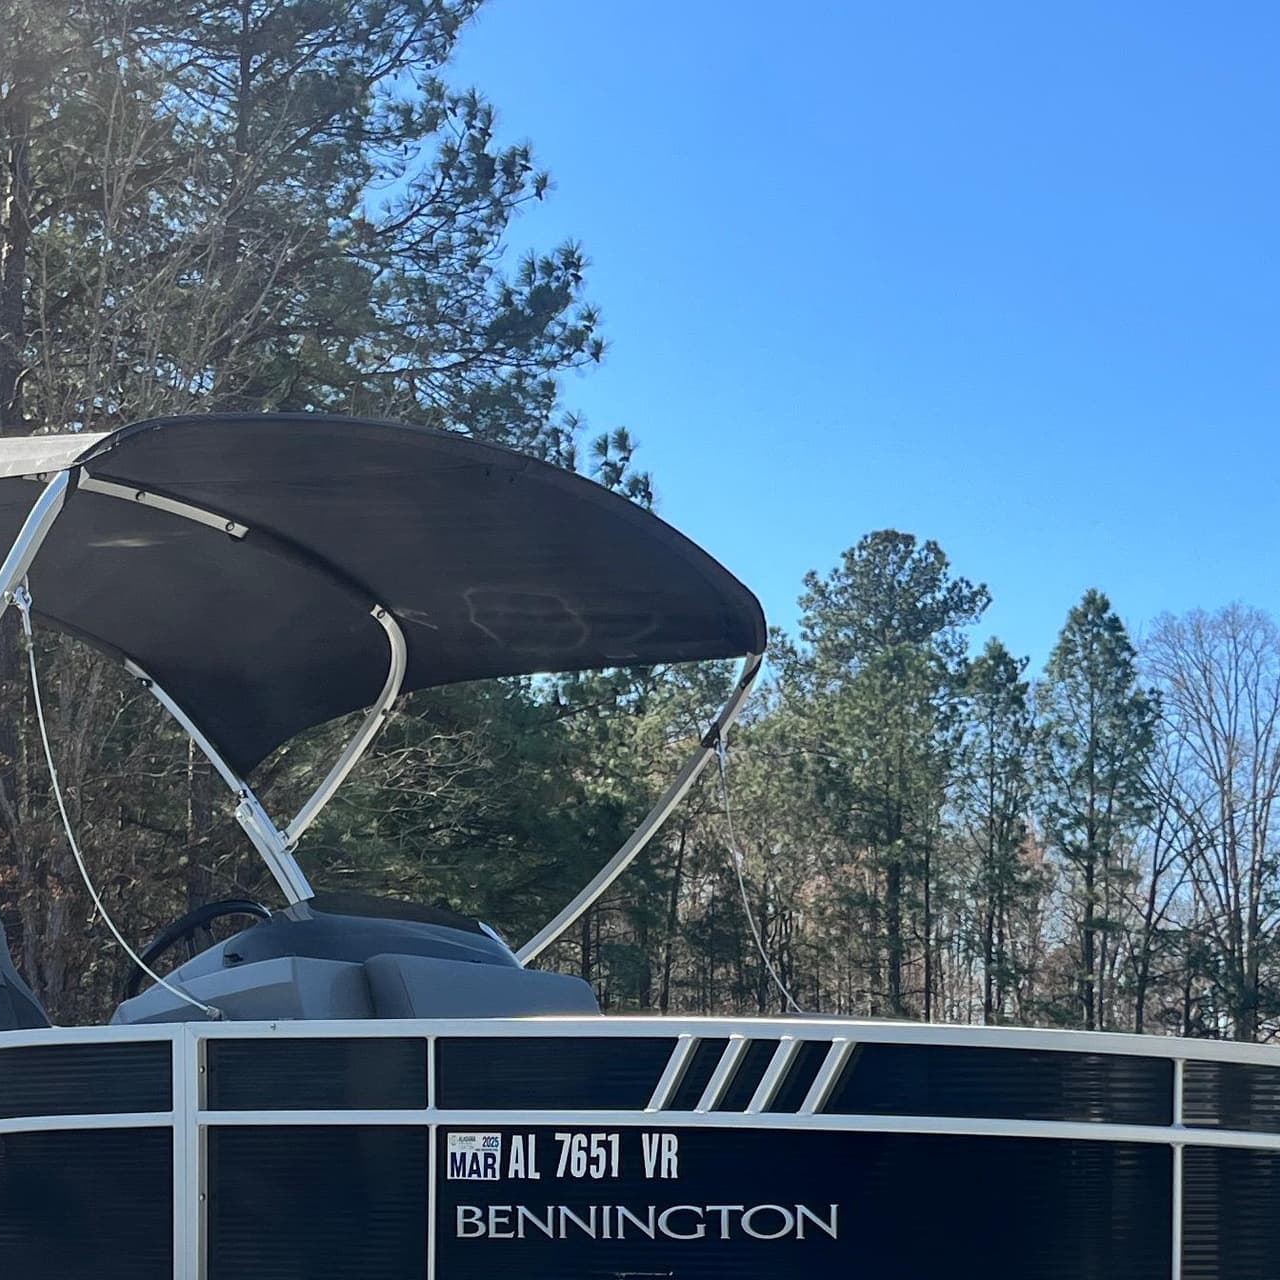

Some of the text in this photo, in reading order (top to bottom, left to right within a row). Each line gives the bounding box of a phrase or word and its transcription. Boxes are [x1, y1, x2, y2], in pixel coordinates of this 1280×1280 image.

[482, 1135, 500, 1148] 2025
[508, 1132, 679, 1180] AL 7651 VR
[450, 1151, 497, 1178] MAR
[455, 1204, 840, 1241] BENNINGTON
